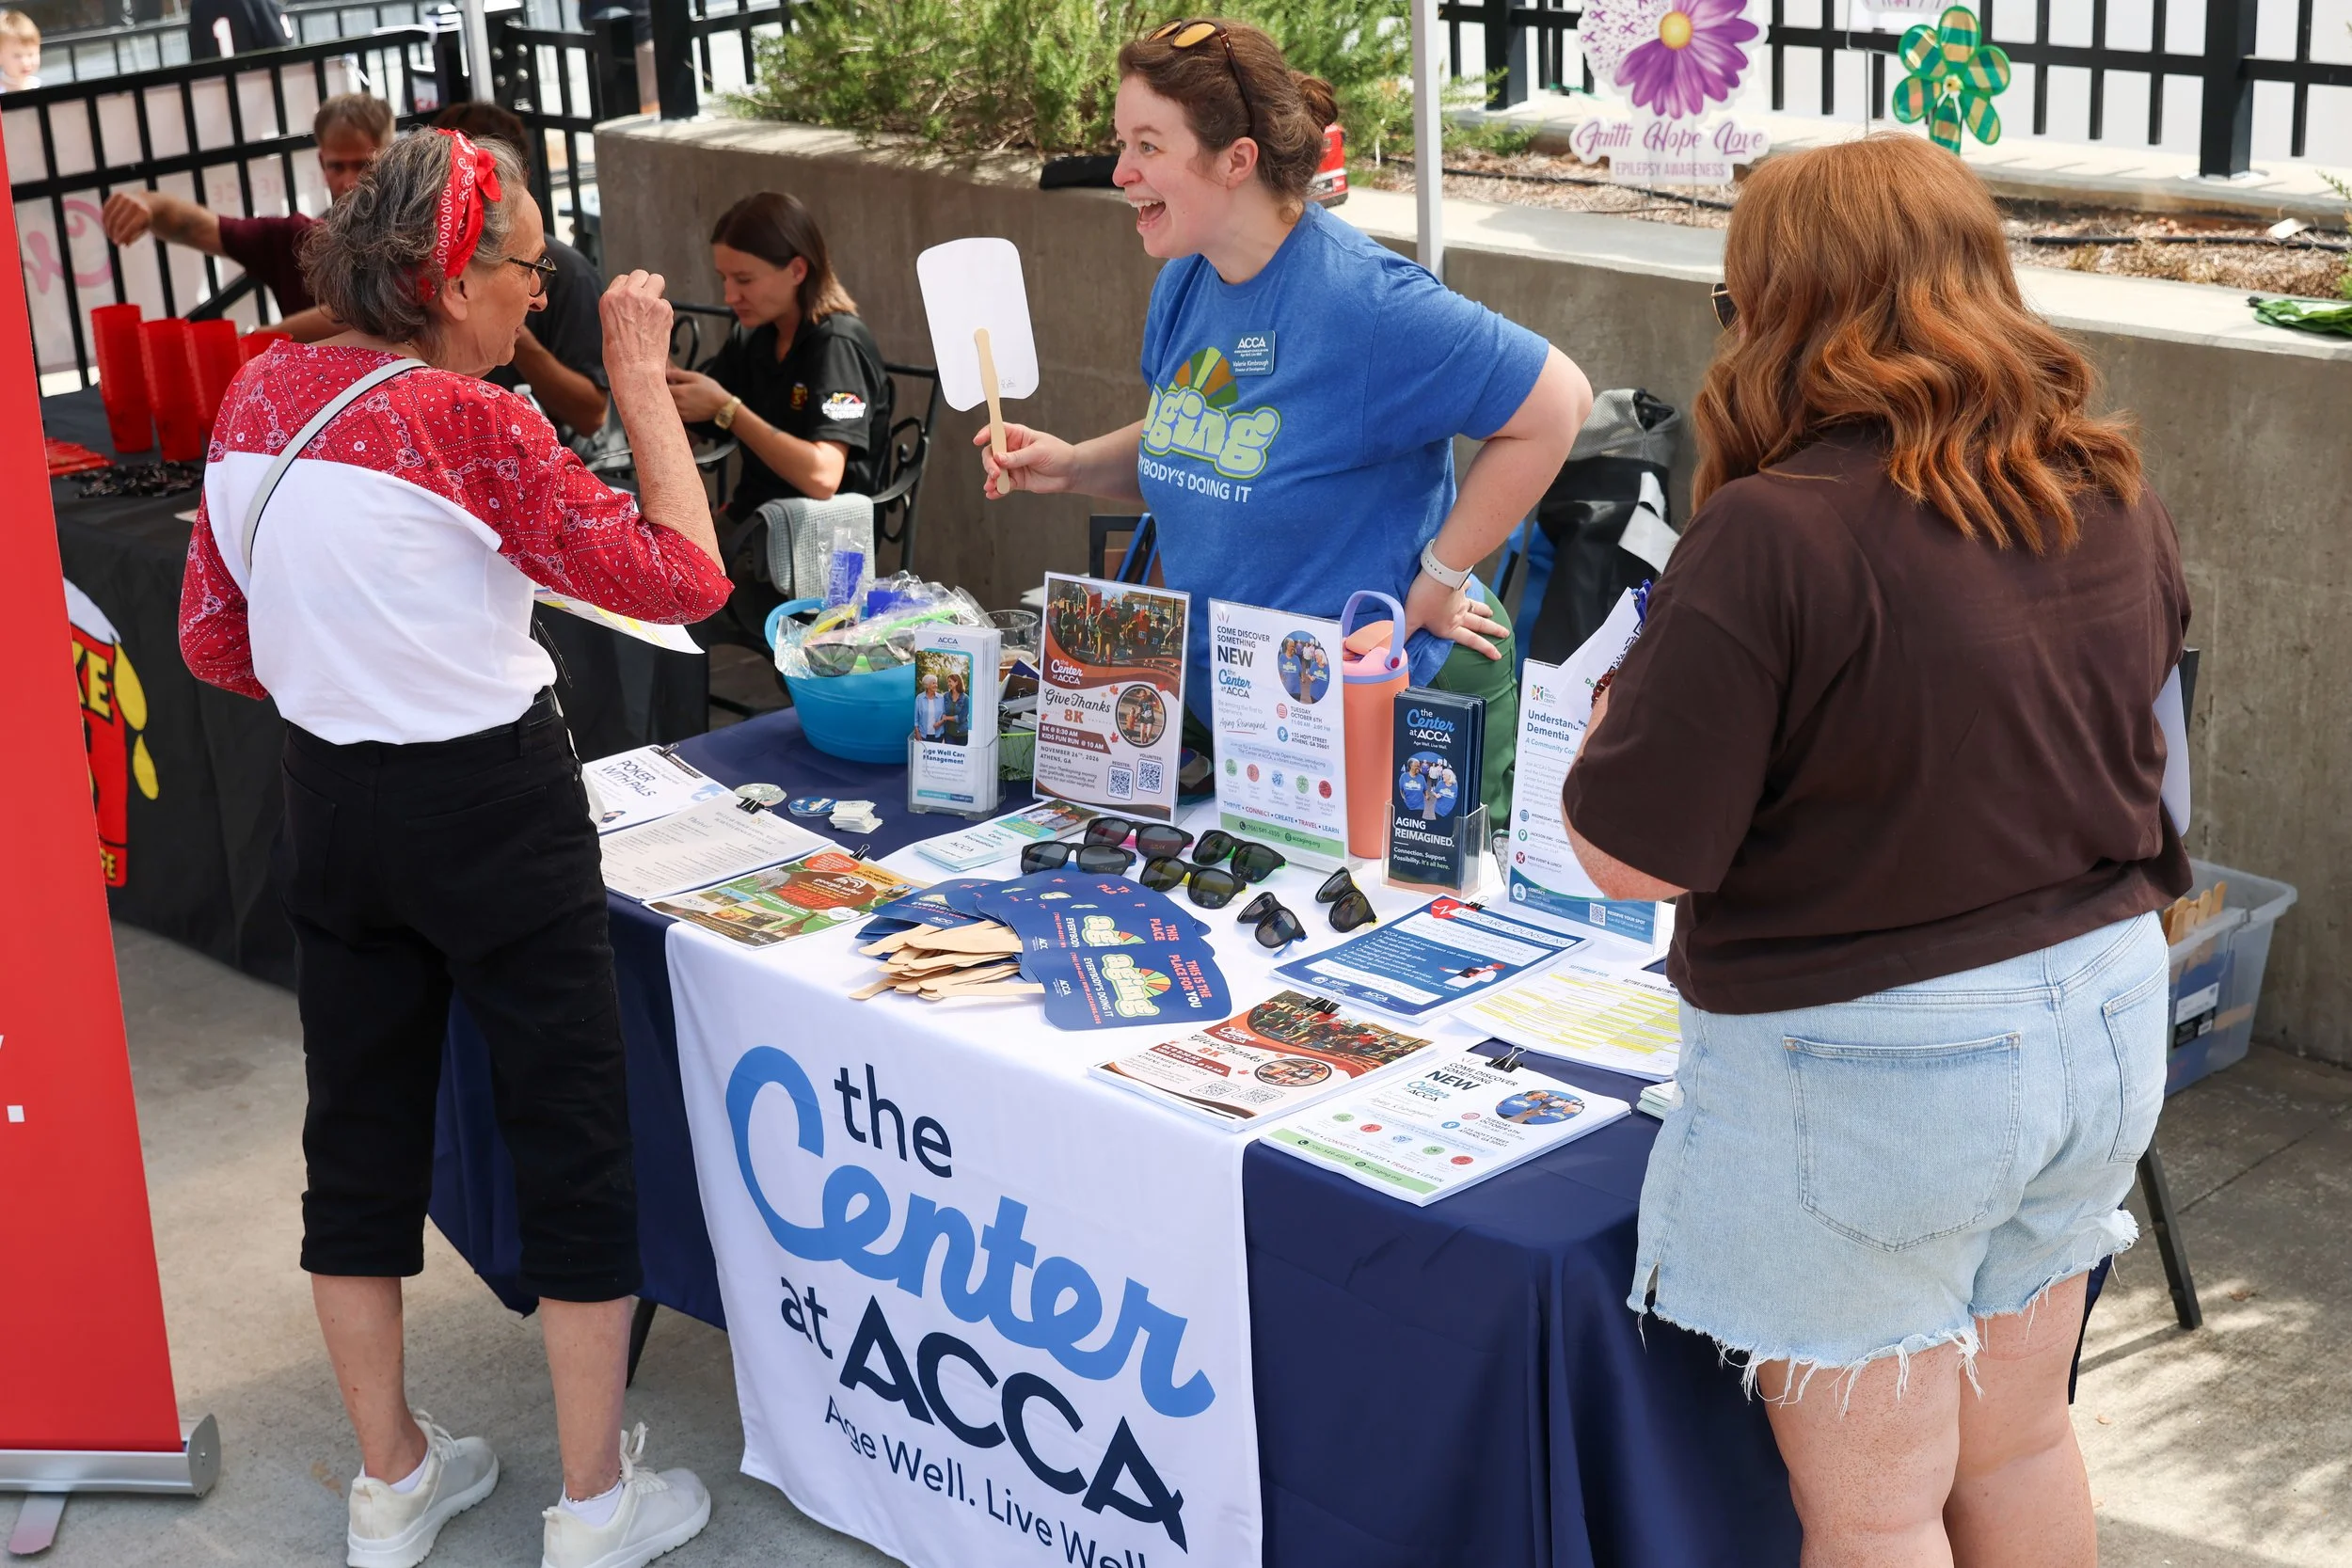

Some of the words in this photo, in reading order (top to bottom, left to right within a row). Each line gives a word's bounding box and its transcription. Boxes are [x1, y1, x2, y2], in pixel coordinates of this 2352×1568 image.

[212, 17, 235, 58] 1
[1644, 120, 1703, 157] Hope
[1714, 120, 1764, 155] Love
[1614, 162, 1661, 177] EPILEPSY
[1663, 162, 1725, 178] AWARENESS
[1237, 336, 1266, 349] ACCA
[1187, 473, 1231, 500] DOING
[1234, 484, 1252, 503] IT
[1216, 626, 1236, 636] COME
[1237, 629, 1270, 642] DISCOVER
[1216, 634, 1256, 649] SOMETHING
[1217, 644, 1254, 668] NEW
[1051, 659, 1083, 676] Center
[1057, 675, 1081, 685] ACCA
[1218, 668, 1252, 689] Center
[1044, 689, 1073, 706] Give
[1072, 693, 1111, 713] Thanks
[1226, 687, 1250, 699] ACCA
[1064, 708, 1084, 724] 8K
[1291, 713, 1312, 722] OCTOBER
[1407, 709, 1454, 732] Center
[1421, 708, 1433, 717] the
[1056, 727, 1069, 736] 8:30
[1417, 729, 1451, 744] ACCA
[1527, 722, 1570, 741] Dementia
[1067, 736, 1080, 745] RUN
[1531, 738, 1564, 753] Community
[1040, 754, 1063, 763] ATHENS,
[1041, 745, 1071, 756] NOVEMBER
[923, 754, 963, 765] Management
[617, 760, 656, 783] POKER
[602, 765, 633, 786] WITH
[628, 780, 657, 797] PALS
[1223, 800, 1241, 810] THRIVE
[1246, 806, 1270, 817] CONNECT
[1274, 813, 1294, 824] CREATE
[1298, 818, 1318, 829] TRAVEL
[1322, 824, 1339, 834] LEARN
[1396, 816, 1426, 830] AGING
[1395, 827, 1454, 847] REIMAGINED.
[950, 841, 975, 853] ACCA
[1394, 847, 1424, 857] Connection.
[1425, 852, 1446, 862] Support.
[1393, 854, 1421, 865] Possibility.
[1437, 862, 1450, 870] here.
[1607, 910, 1624, 919] RESERVE
[1149, 918, 1165, 941] PLACE
[1166, 924, 1179, 941] THIS
[1457, 909, 1504, 927] MEDICARE
[1505, 922, 1570, 947] COUNSELING
[1168, 954, 1187, 976] PLACE
[1569, 965, 1597, 974] SEPTEMBER
[1058, 979, 1072, 995] ACCA
[1084, 958, 1104, 991] EVERYBODY'S
[1099, 990, 1111, 1012] DOING
[1102, 954, 1160, 1017] aging
[1180, 975, 1194, 991] FOR
[1185, 960, 1201, 977] THIS
[1195, 976, 1205, 985] IS
[1200, 984, 1212, 998] THE
[1329, 979, 1350, 988] SHIP
[1186, 990, 1202, 1008] YOU
[1364, 991, 1388, 1002] ACCA
[1220, 1027, 1256, 1042] Center
[1222, 1033, 1247, 1044] ACCA
[1188, 1034, 1217, 1048] Give
[1217, 1044, 1264, 1063] Thanks
[1197, 1047, 1225, 1058] 8K
[1145, 1052, 1177, 1066] NOVEMBER
[1184, 1056, 1198, 1065] RUN
[1425, 1071, 1481, 1091] NEW
[1441, 1066, 1493, 1085] SOMETHING
[1449, 1062, 1474, 1074] COME
[1474, 1071, 1518, 1086] DISCOVER
[1407, 1081, 1452, 1099] Center
[1407, 1089, 1438, 1102] ACCA
[834, 1063, 952, 1178] the
[1480, 1119, 1508, 1130] OCTOBER
[1324, 1136, 1357, 1150] CONNECT
[1360, 1149, 1386, 1162] CREATE
[1391, 1161, 1416, 1174] TRAVEL
[1421, 1172, 1445, 1183] LEARN
[1365, 1164, 1403, 1181] accaging.org
[725, 1045, 1216, 1418] Center
[780, 1276, 833, 1359] at
[839, 1295, 1188, 1554] ACCA
[824, 1394, 876, 1460] Age
[882, 1434, 976, 1507] Well.
[986, 1478, 1053, 1547] Live
